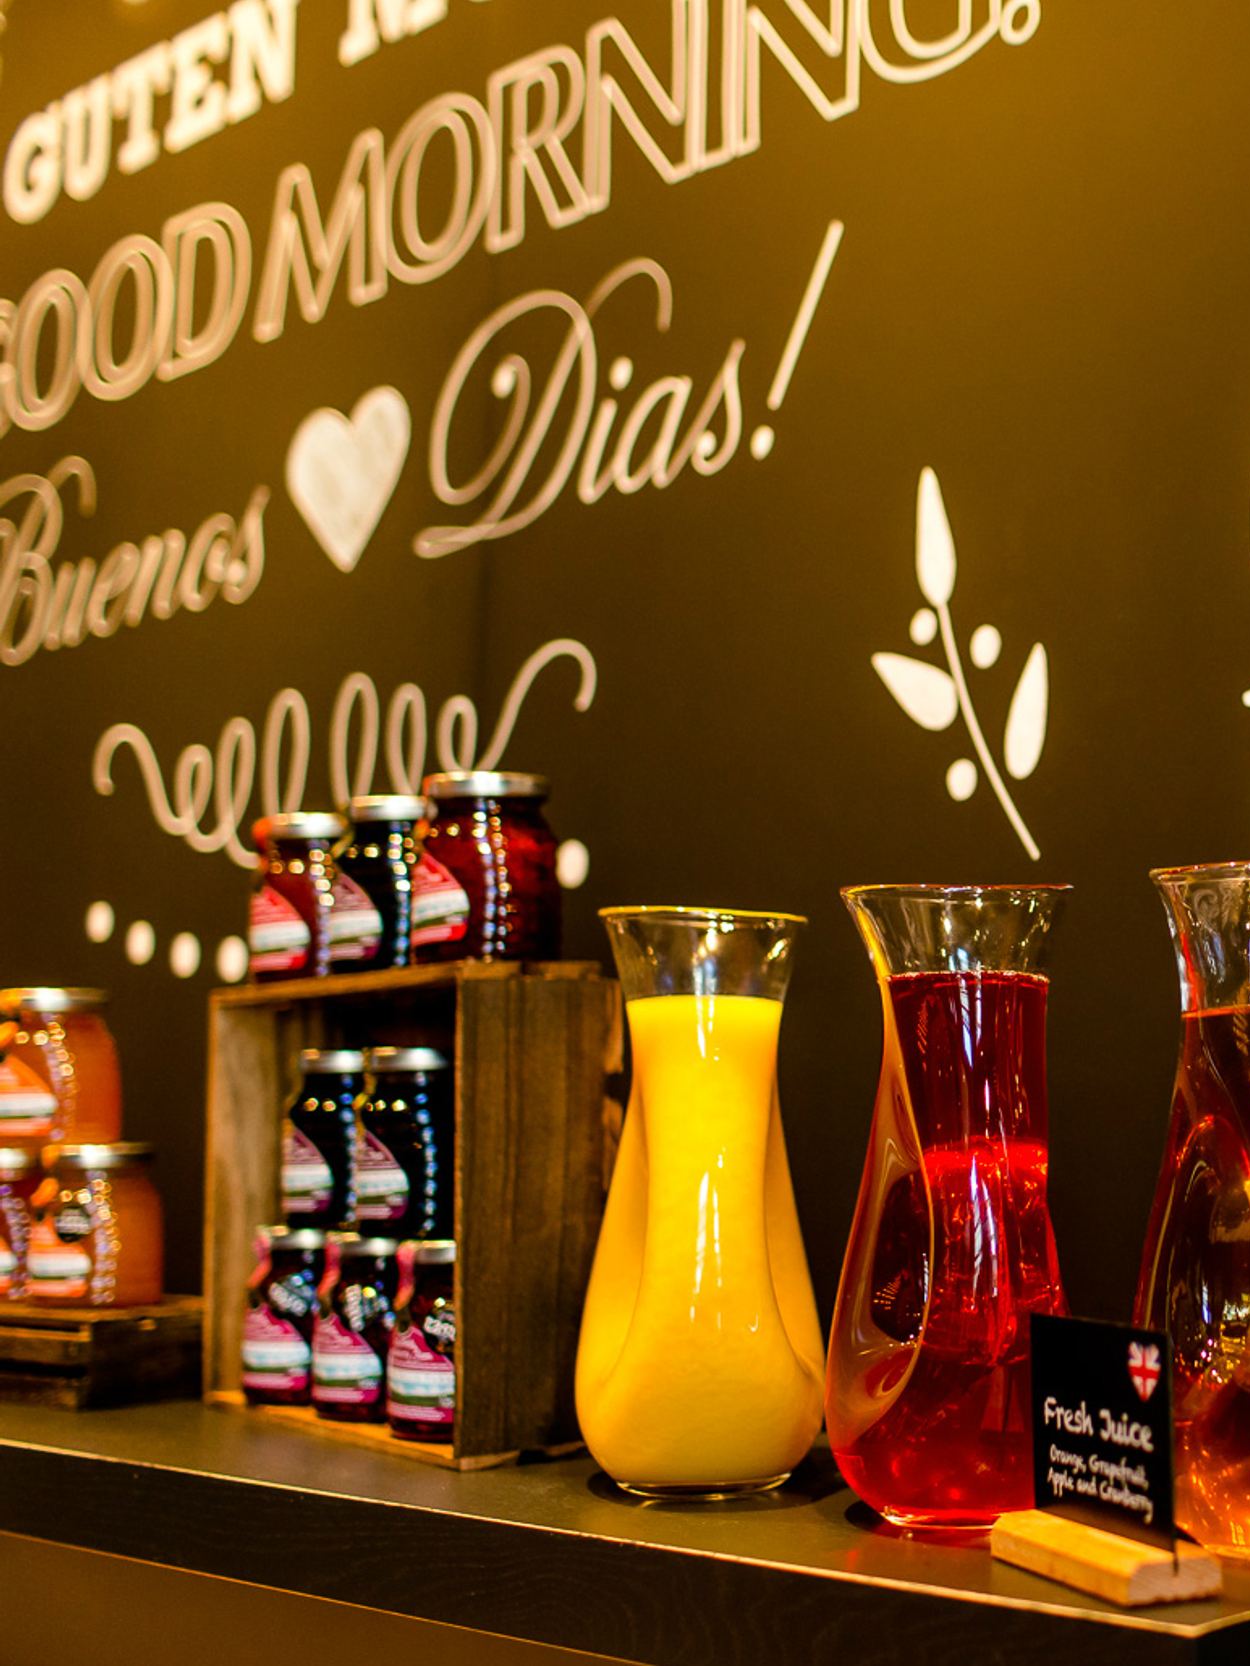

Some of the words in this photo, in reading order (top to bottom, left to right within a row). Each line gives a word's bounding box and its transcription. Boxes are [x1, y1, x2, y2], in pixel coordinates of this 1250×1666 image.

[3, 0, 298, 225] GUTEN
[0, 202, 252, 440] OOD
[253, 0, 1041, 344] MORNIN
[1044, 1396, 1094, 1436] Fresh
[1099, 1408, 1154, 1453] Juice
[1047, 1467, 1075, 1498] Apple
[1076, 1475, 1098, 1497] and
